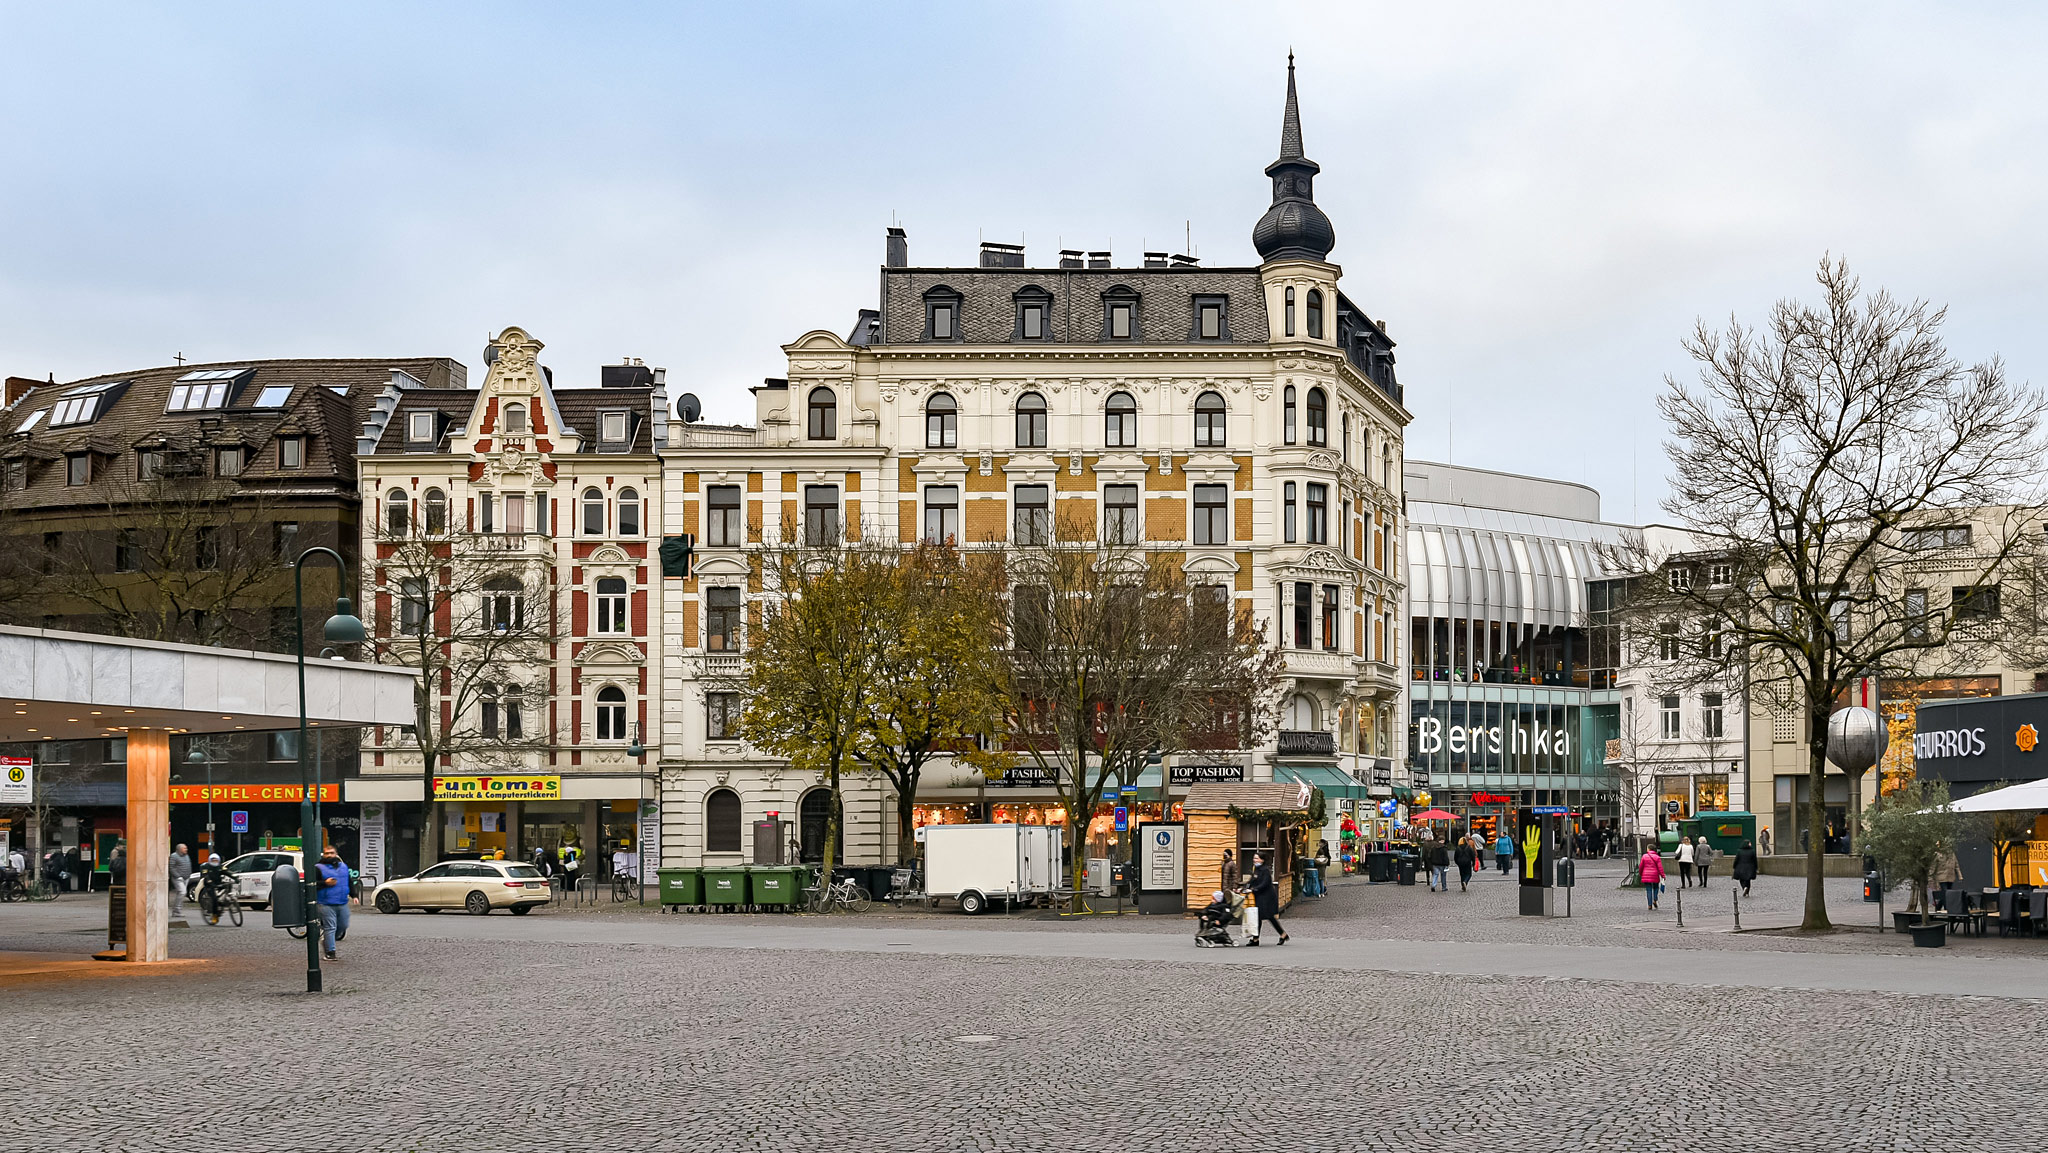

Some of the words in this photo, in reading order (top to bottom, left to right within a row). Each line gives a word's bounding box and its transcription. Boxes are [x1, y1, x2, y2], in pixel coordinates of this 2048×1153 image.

[1419, 717, 1570, 755] Bershka
[1171, 767, 1194, 777] TOP
[1196, 767, 1241, 777] FASHION
[433, 777, 557, 791] FunTomas
[170, 787, 329, 800] TY-SPIEL-CENTER
[433, 791, 474, 799] extildruck
[476, 790, 483, 798] &
[485, 791, 558, 800] Computerstickerei
